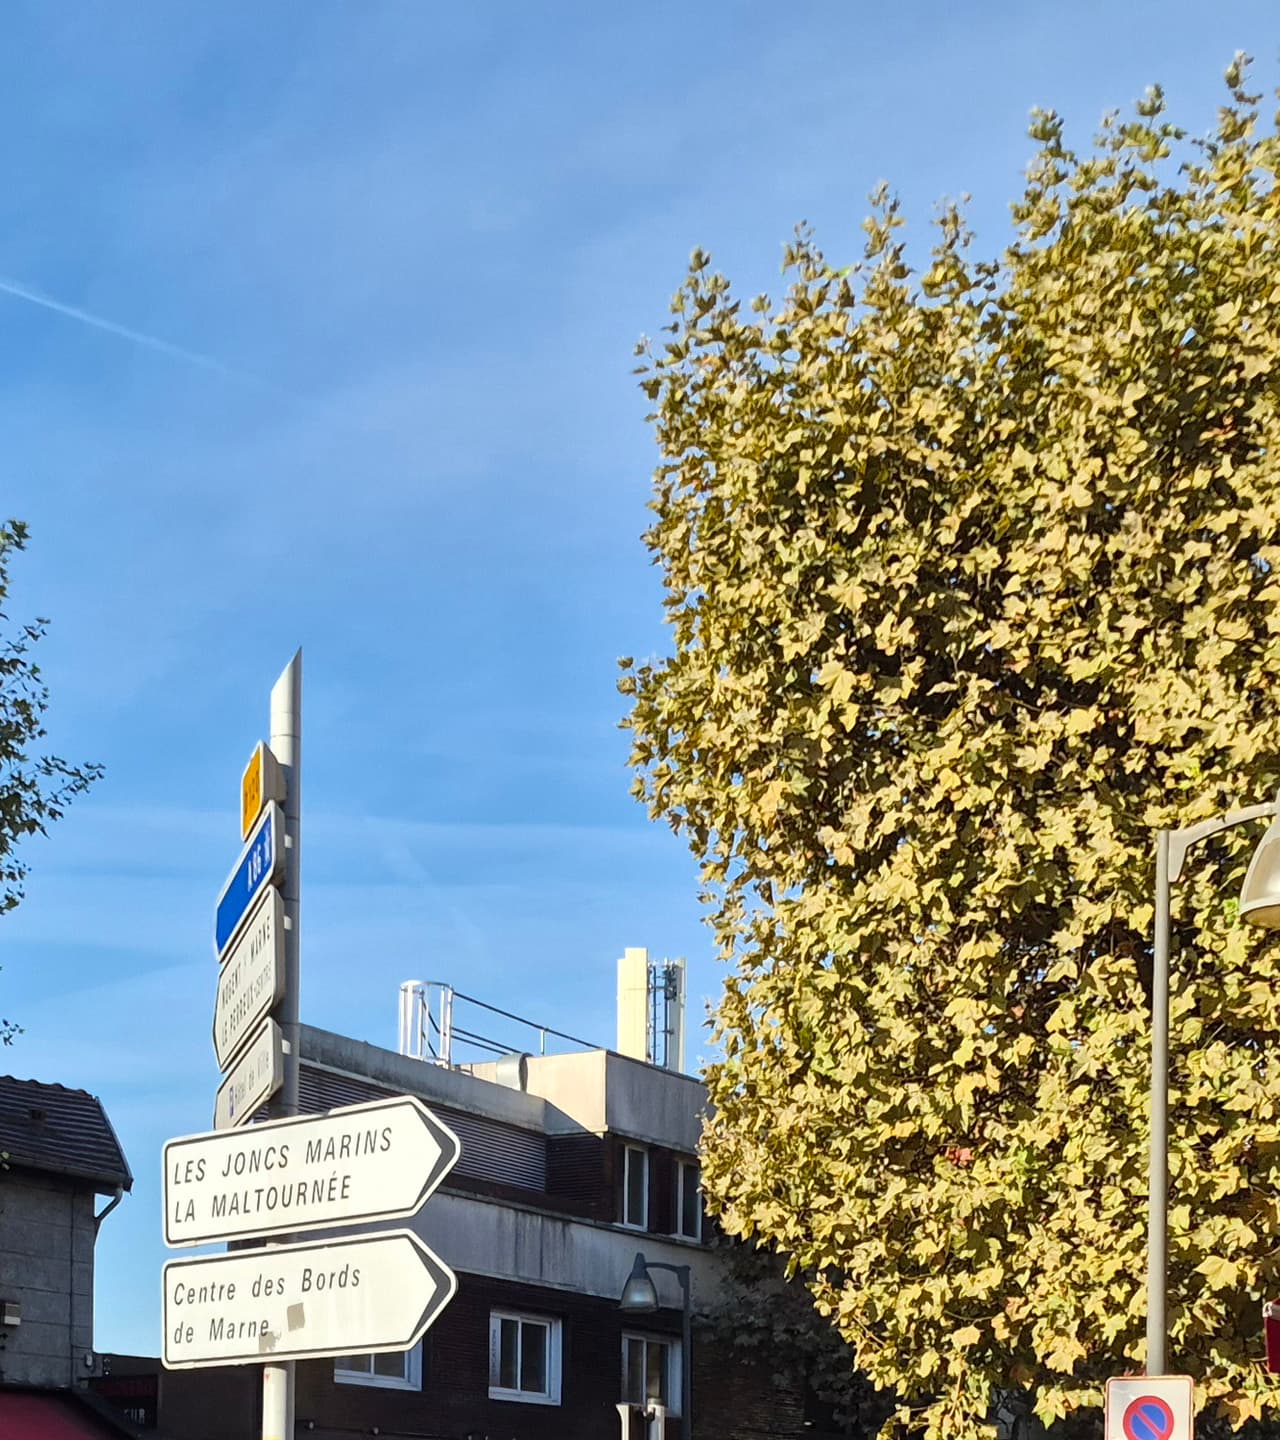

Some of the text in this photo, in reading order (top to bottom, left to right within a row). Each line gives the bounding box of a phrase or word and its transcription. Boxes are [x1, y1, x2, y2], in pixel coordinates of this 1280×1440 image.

[221, 963, 241, 1011] NOGENT
[250, 915, 271, 966] MARNE
[174, 1127, 392, 1185] LES JONCS MARINS
[175, 1171, 352, 1223] LA MALTOURNÉE
[174, 1263, 361, 1305] Centre des Bords
[174, 1317, 269, 1344] de Marne
